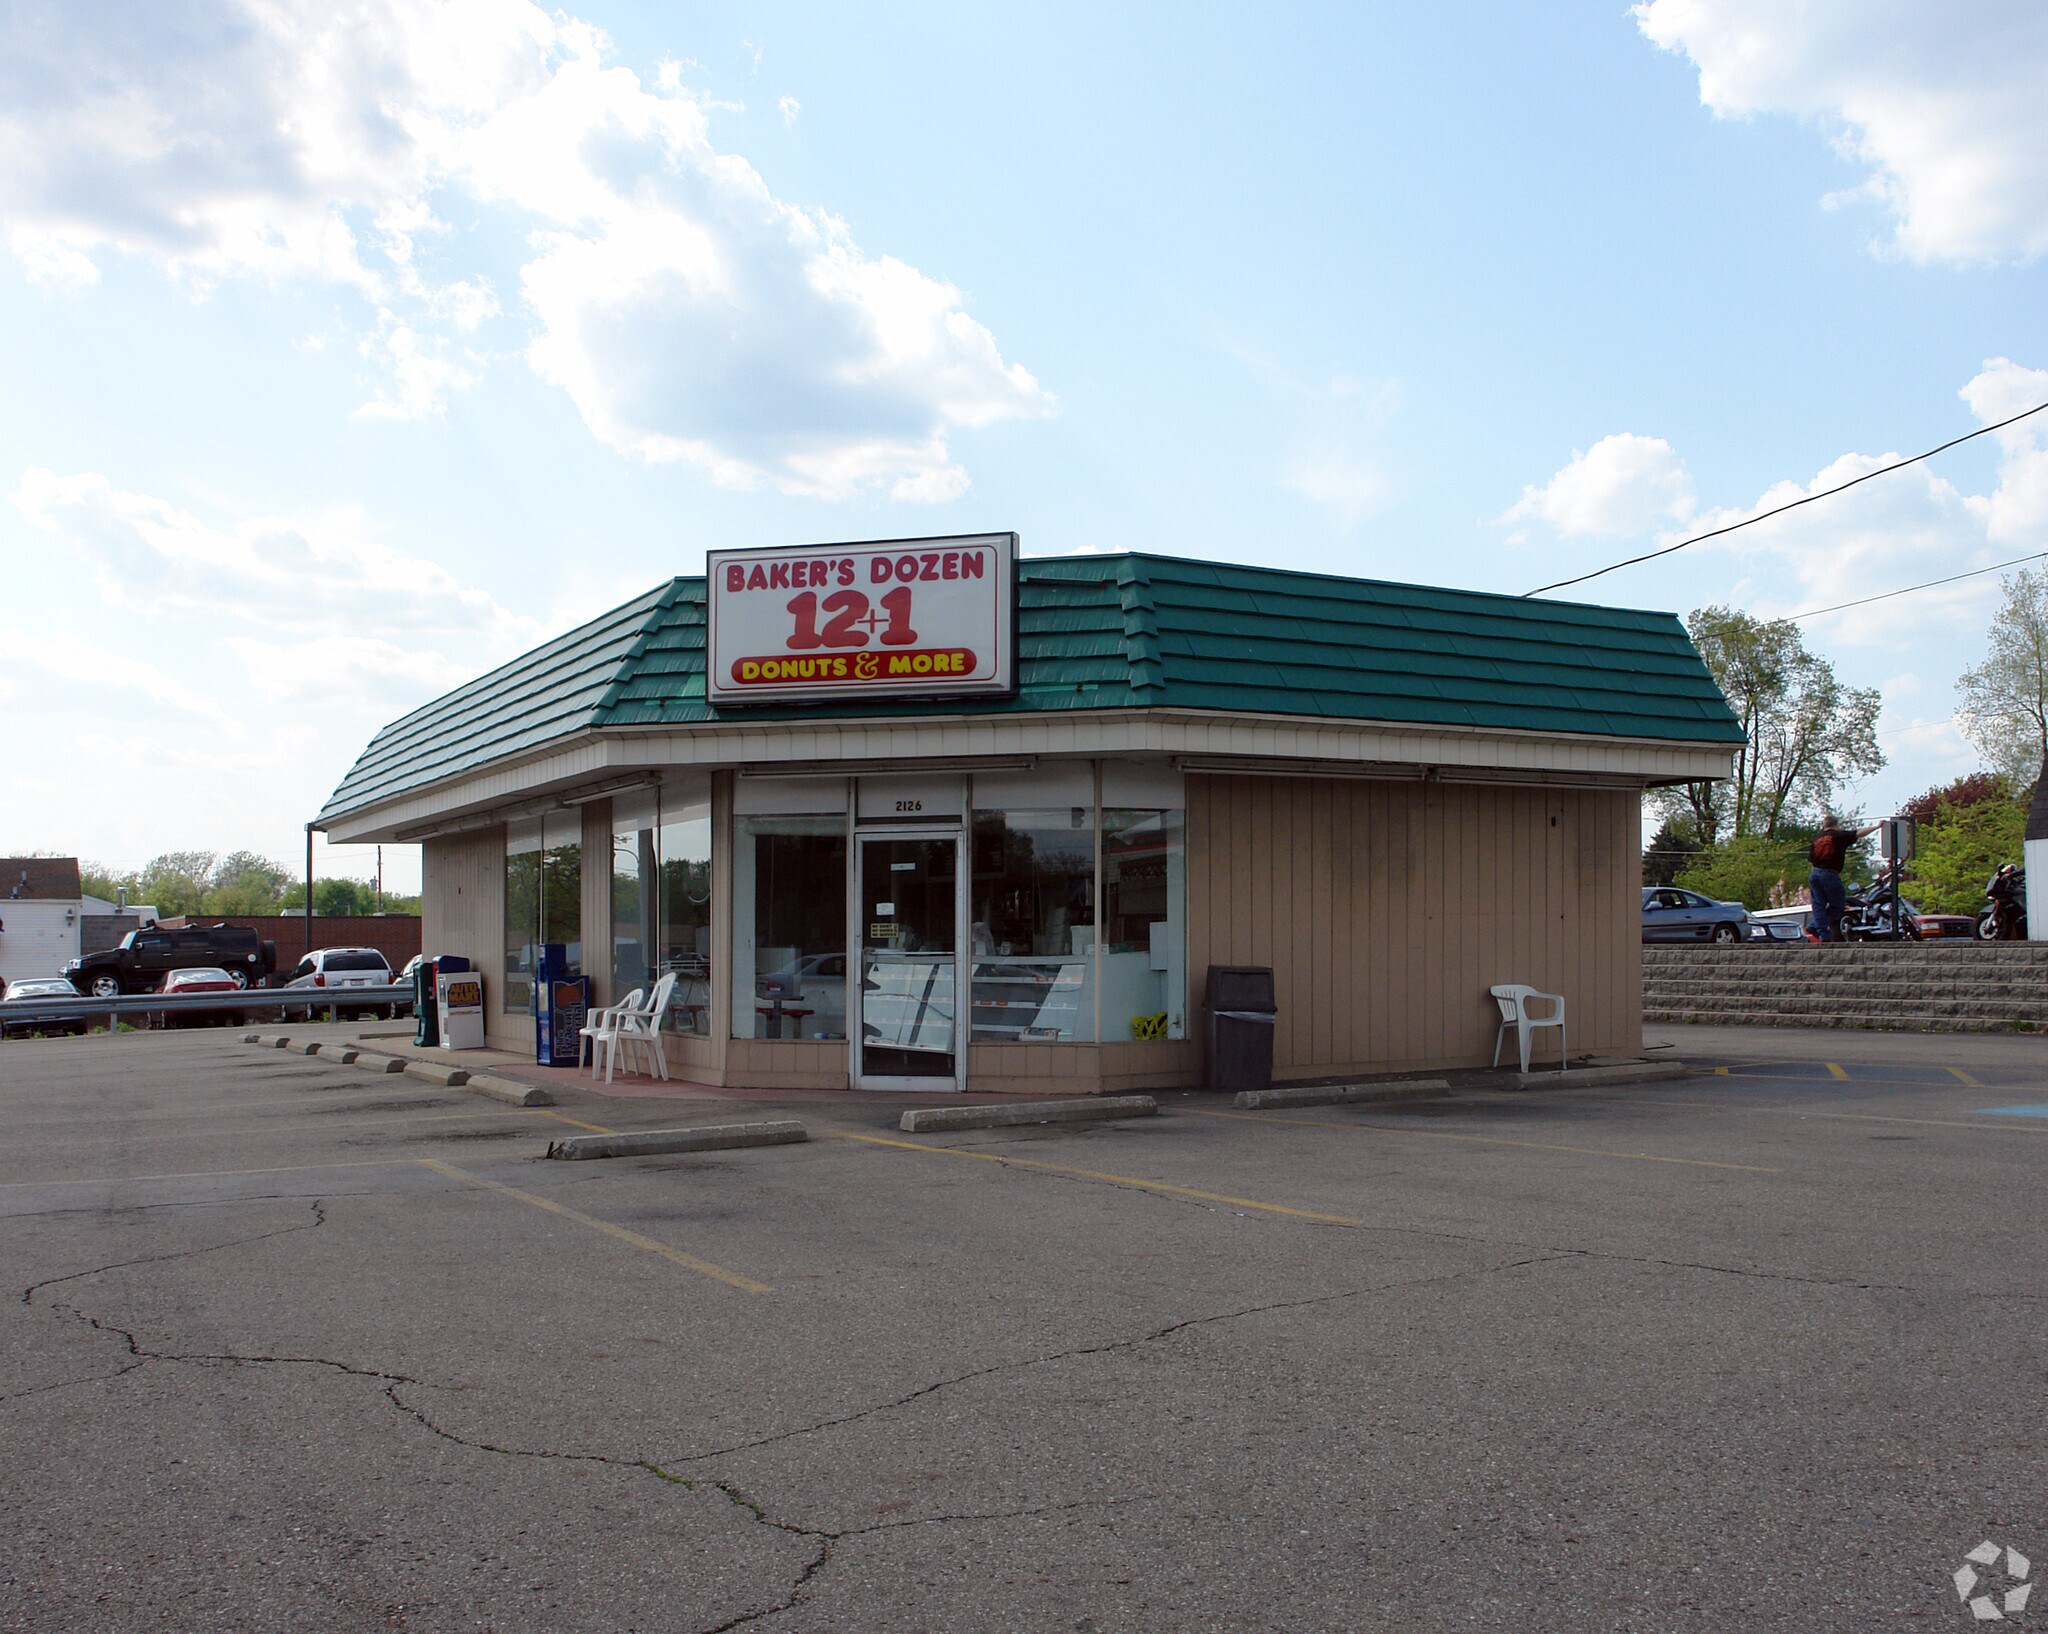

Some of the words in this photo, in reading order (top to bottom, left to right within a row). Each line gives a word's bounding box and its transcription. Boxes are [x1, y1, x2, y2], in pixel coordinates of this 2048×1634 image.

[727, 559, 855, 592] BAKER'S
[871, 551, 984, 584] DOZEN
[786, 586, 918, 650] 12+1
[742, 658, 848, 680] DONUTS
[854, 652, 878, 680] &
[888, 653, 965, 674] MORE
[895, 800, 922, 812] 2126
[448, 992, 480, 1004] MART
[449, 983, 479, 993] AUTO
[561, 1008, 573, 1055] Beacon
